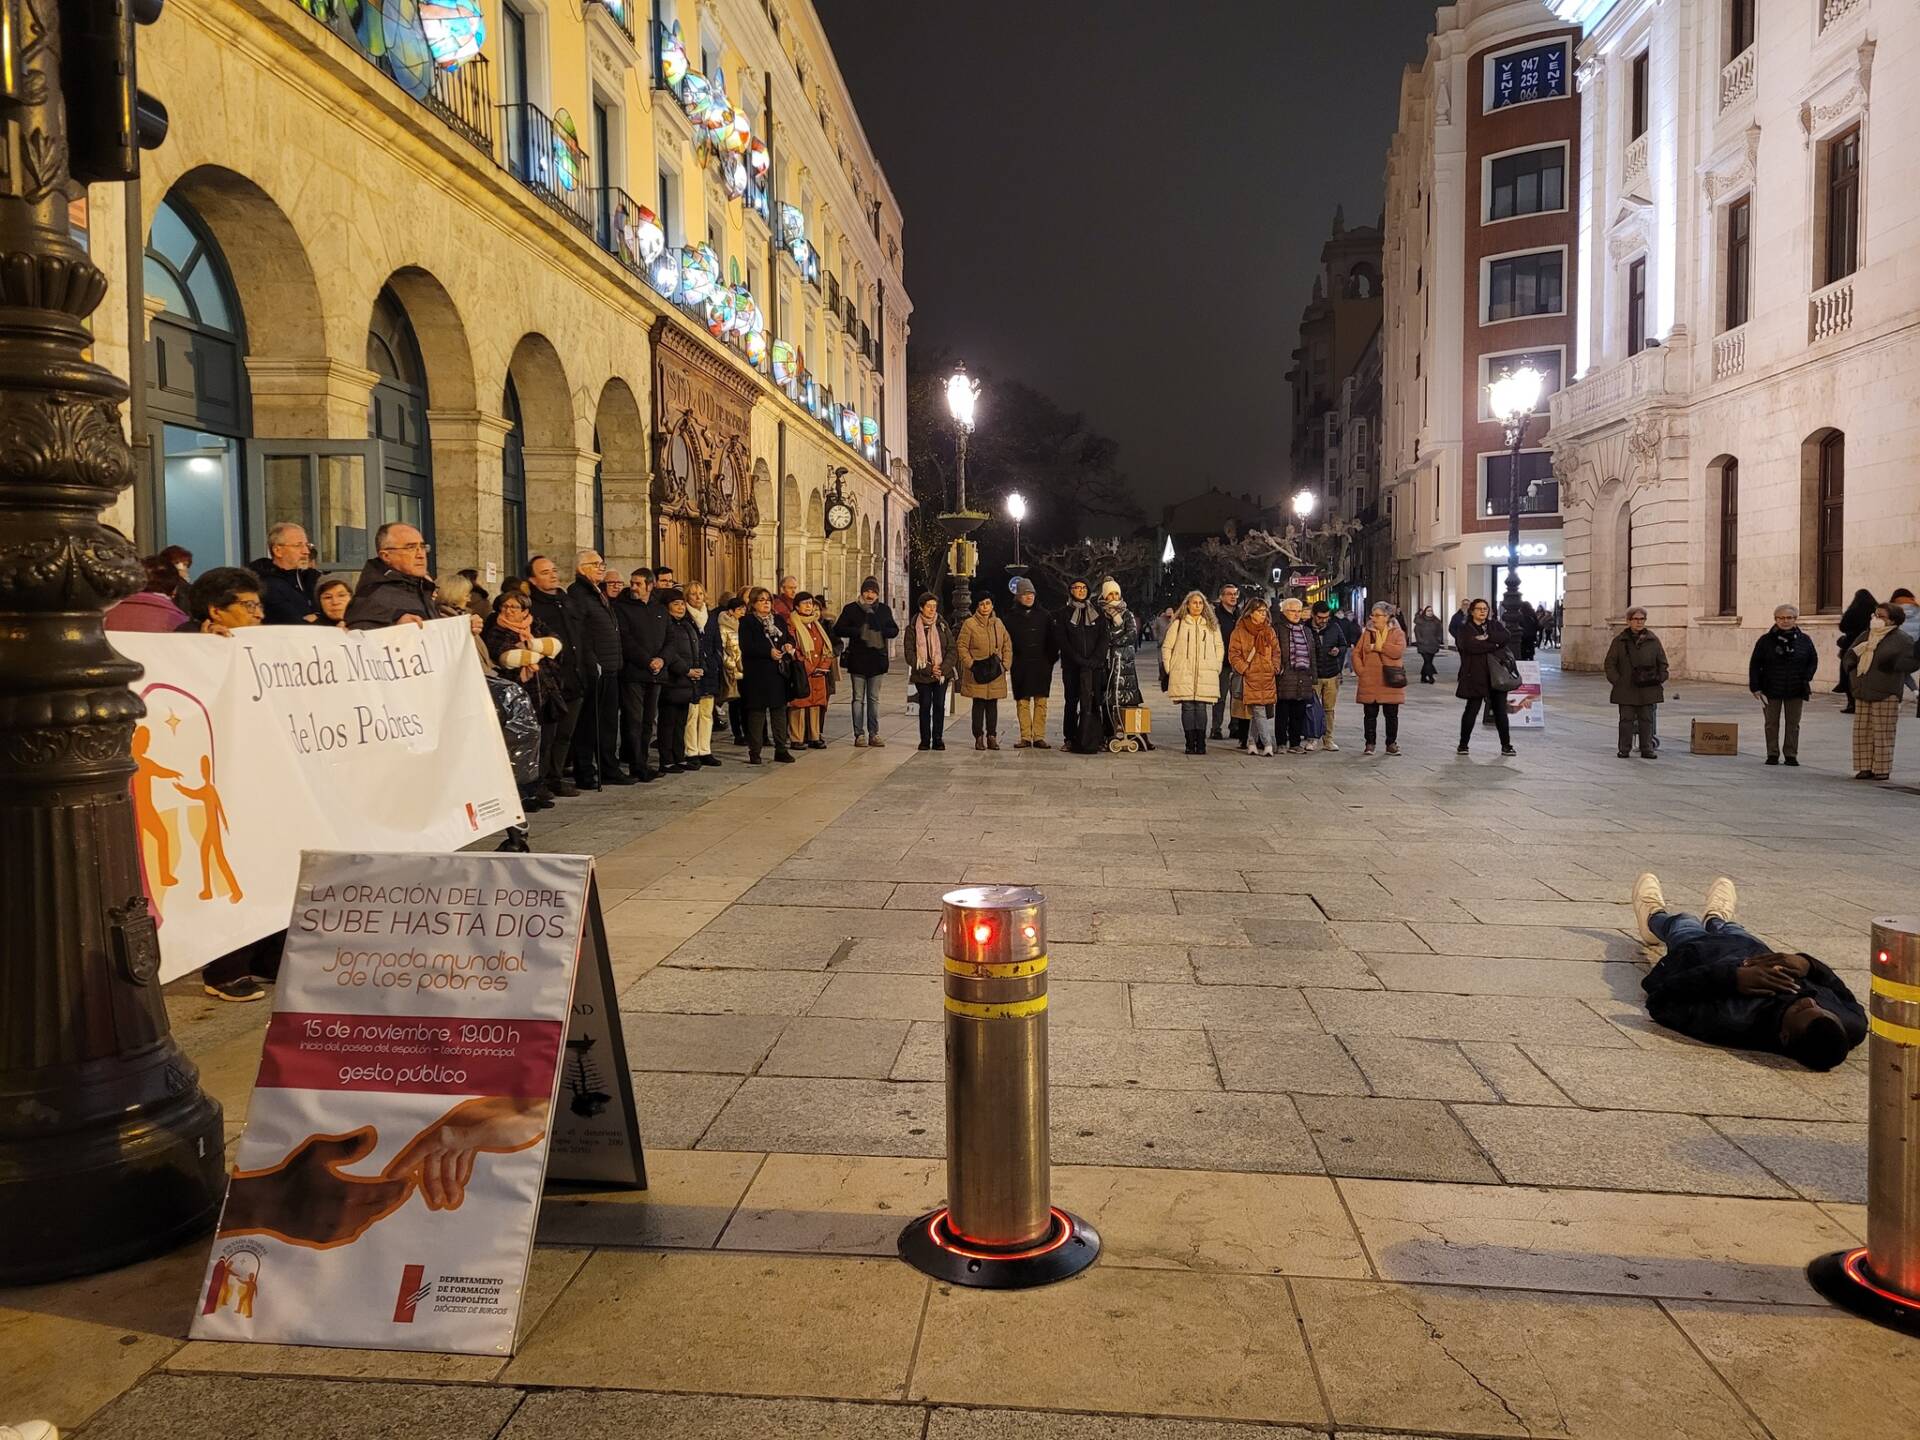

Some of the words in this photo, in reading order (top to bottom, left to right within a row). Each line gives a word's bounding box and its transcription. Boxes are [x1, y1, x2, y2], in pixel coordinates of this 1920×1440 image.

[1521, 56, 1539, 72] 947
[1548, 52, 1560, 97] VENTA
[1501, 62, 1513, 106] VENTA
[1520, 72, 1538, 87] 252
[1520, 87, 1538, 101] 066
[244, 644, 338, 702] Jornada
[289, 715, 310, 755] de
[310, 714, 348, 752] los
[355, 705, 424, 745] Pobres
[310, 886, 336, 902] LA
[342, 882, 442, 905] ORACIÓN
[448, 888, 489, 906] DEL
[495, 889, 566, 908] POBRE
[300, 909, 384, 934] SUBE
[391, 911, 486, 936] HASTA
[496, 913, 566, 938] DIOS
[322, 947, 428, 972] jornada
[431, 950, 528, 973] mundial
[336, 968, 368, 988] de
[370, 966, 412, 988] los
[416, 968, 509, 994] pobres
[303, 1019, 322, 1038] 15
[326, 1020, 350, 1038] de
[353, 1023, 453, 1042] noviembre,
[507, 1024, 520, 1044] h
[299, 1041, 323, 1050] inicio
[324, 1042, 340, 1051] del
[341, 1044, 373, 1054] paseo
[374, 1043, 390, 1053] del
[440, 1046, 472, 1056] teatro
[472, 1047, 516, 1058] principal
[338, 1062, 394, 1084] gesto
[396, 1064, 468, 1086] público
[439, 1276, 504, 1286] DEPARTAMENTO
[450, 1286, 500, 1295] FORMACIÓN
[435, 1295, 499, 1304] SOCIOPOLÍTICA
